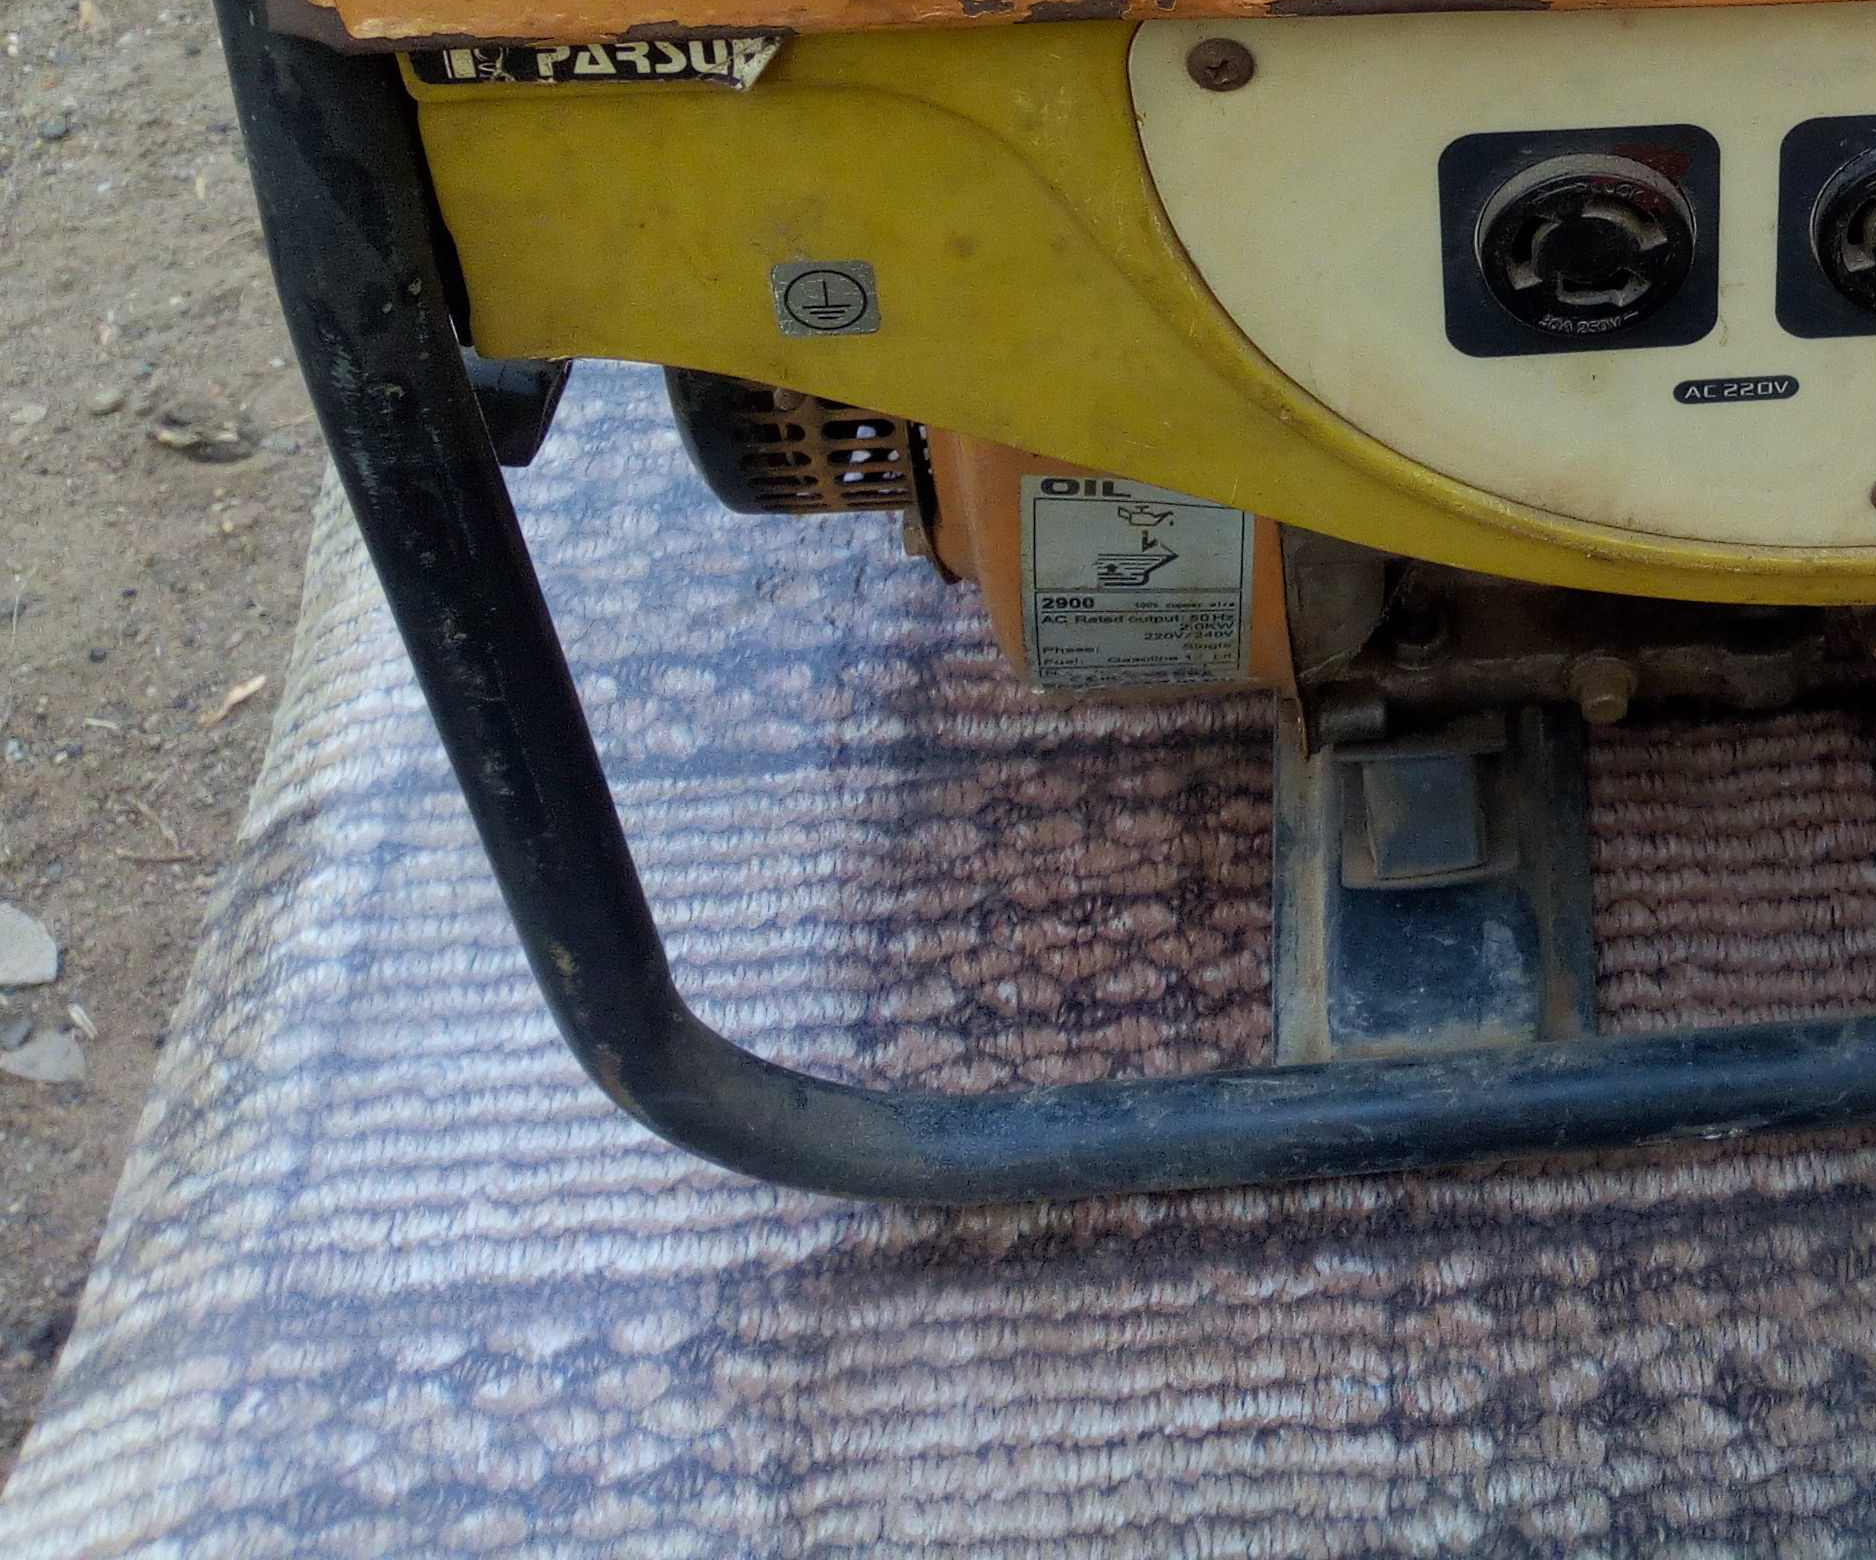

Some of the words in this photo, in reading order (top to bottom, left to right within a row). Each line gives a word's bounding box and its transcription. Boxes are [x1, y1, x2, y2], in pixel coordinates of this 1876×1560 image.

[1684, 381, 1718, 400] AC
[1723, 377, 1790, 399] 220V
[1040, 478, 1131, 498] OIL
[1041, 596, 1095, 610] 2900
[1074, 614, 1124, 624] Rated
